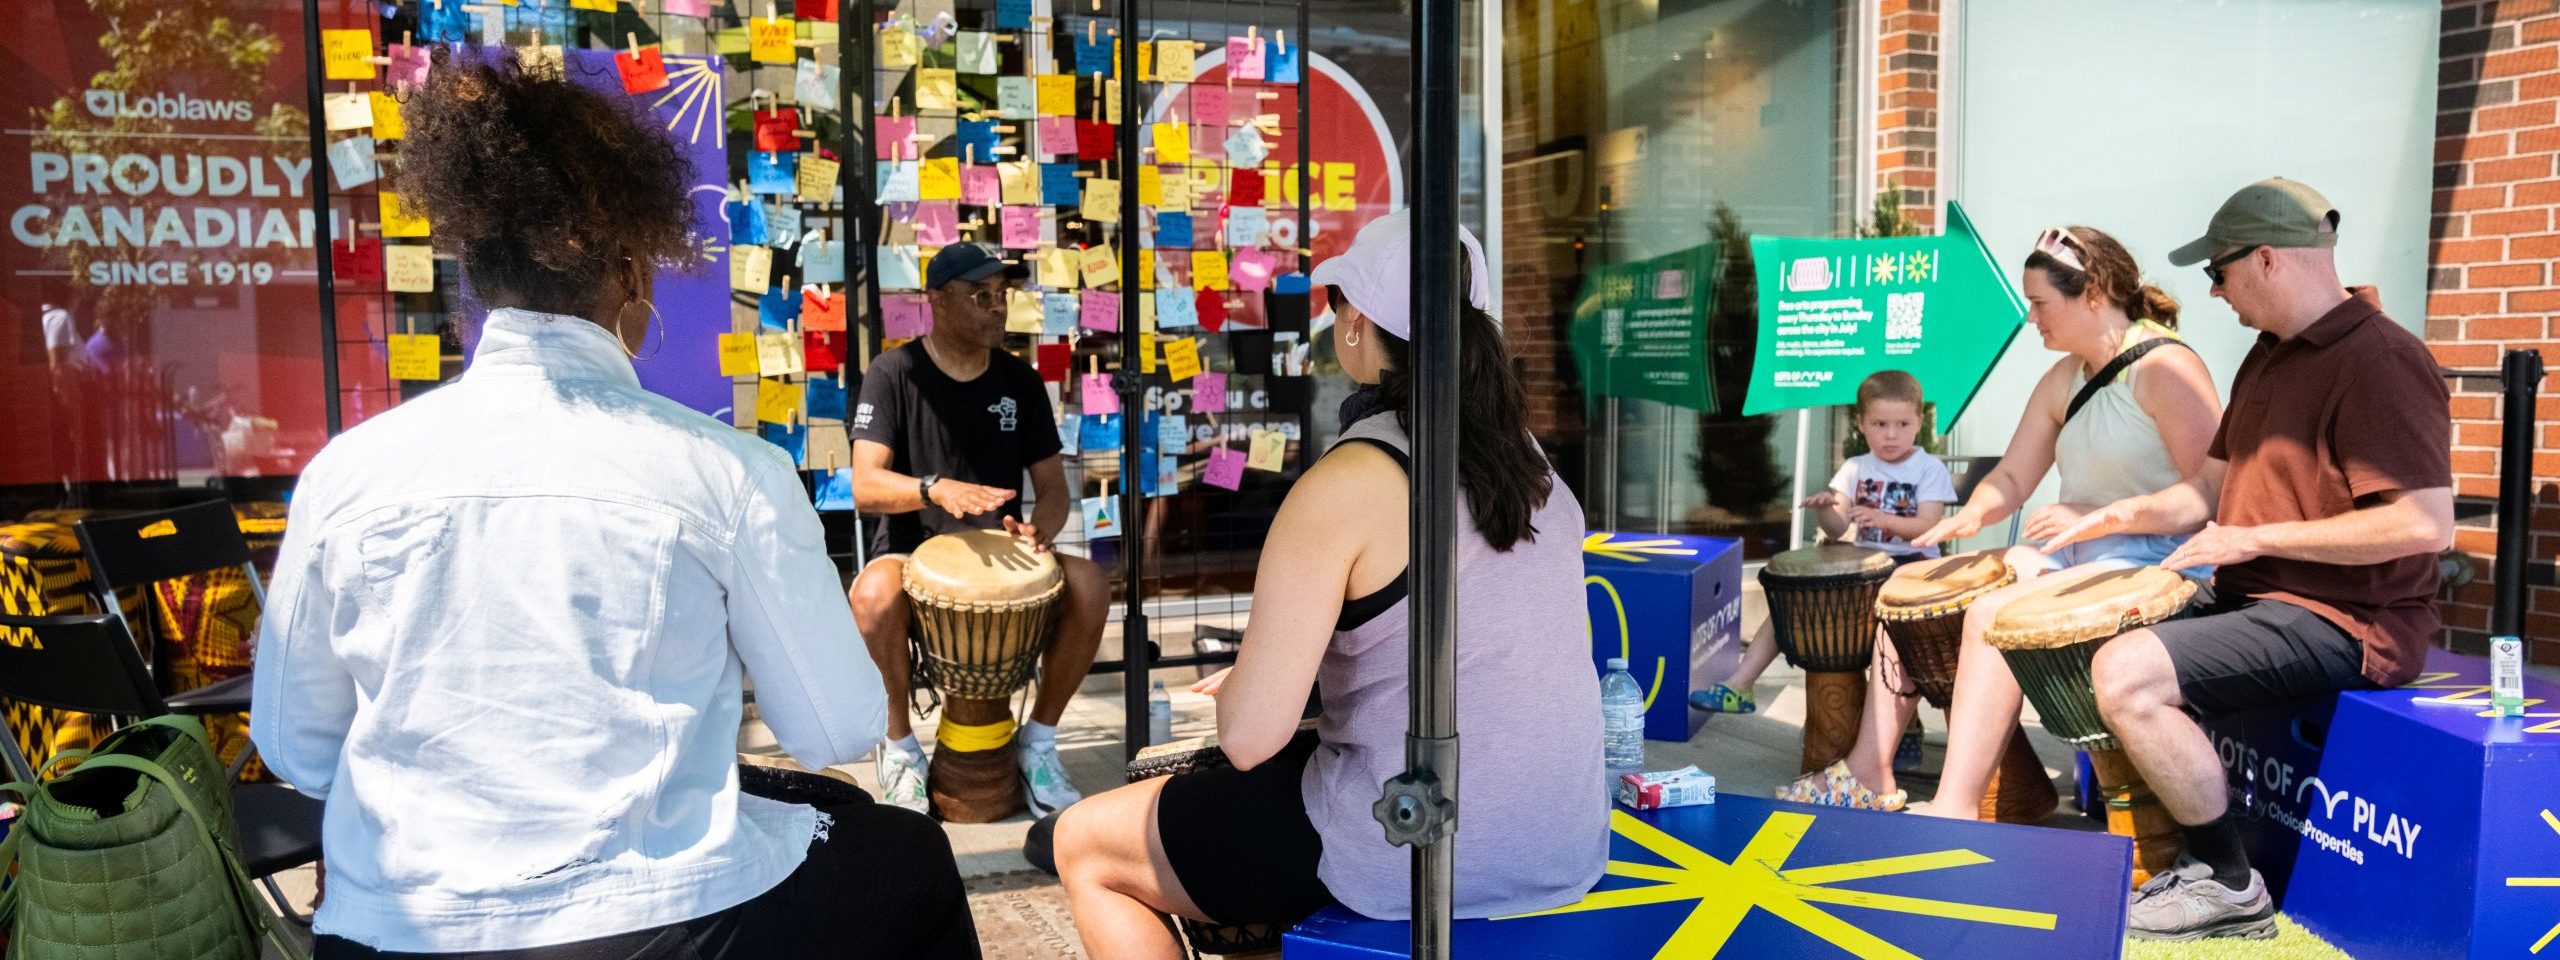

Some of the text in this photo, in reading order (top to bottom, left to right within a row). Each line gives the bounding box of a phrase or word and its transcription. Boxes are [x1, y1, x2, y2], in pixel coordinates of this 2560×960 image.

[118, 93, 253, 122] Loblaws
[30, 152, 312, 197] PROUDLY
[1183, 157, 1357, 211] PICE
[88, 261, 273, 286] SINCE 1919
[2263, 756, 2294, 797] OF
[2353, 795, 2422, 860] PLAY
[2268, 801, 2365, 867] ChoiceProperties
